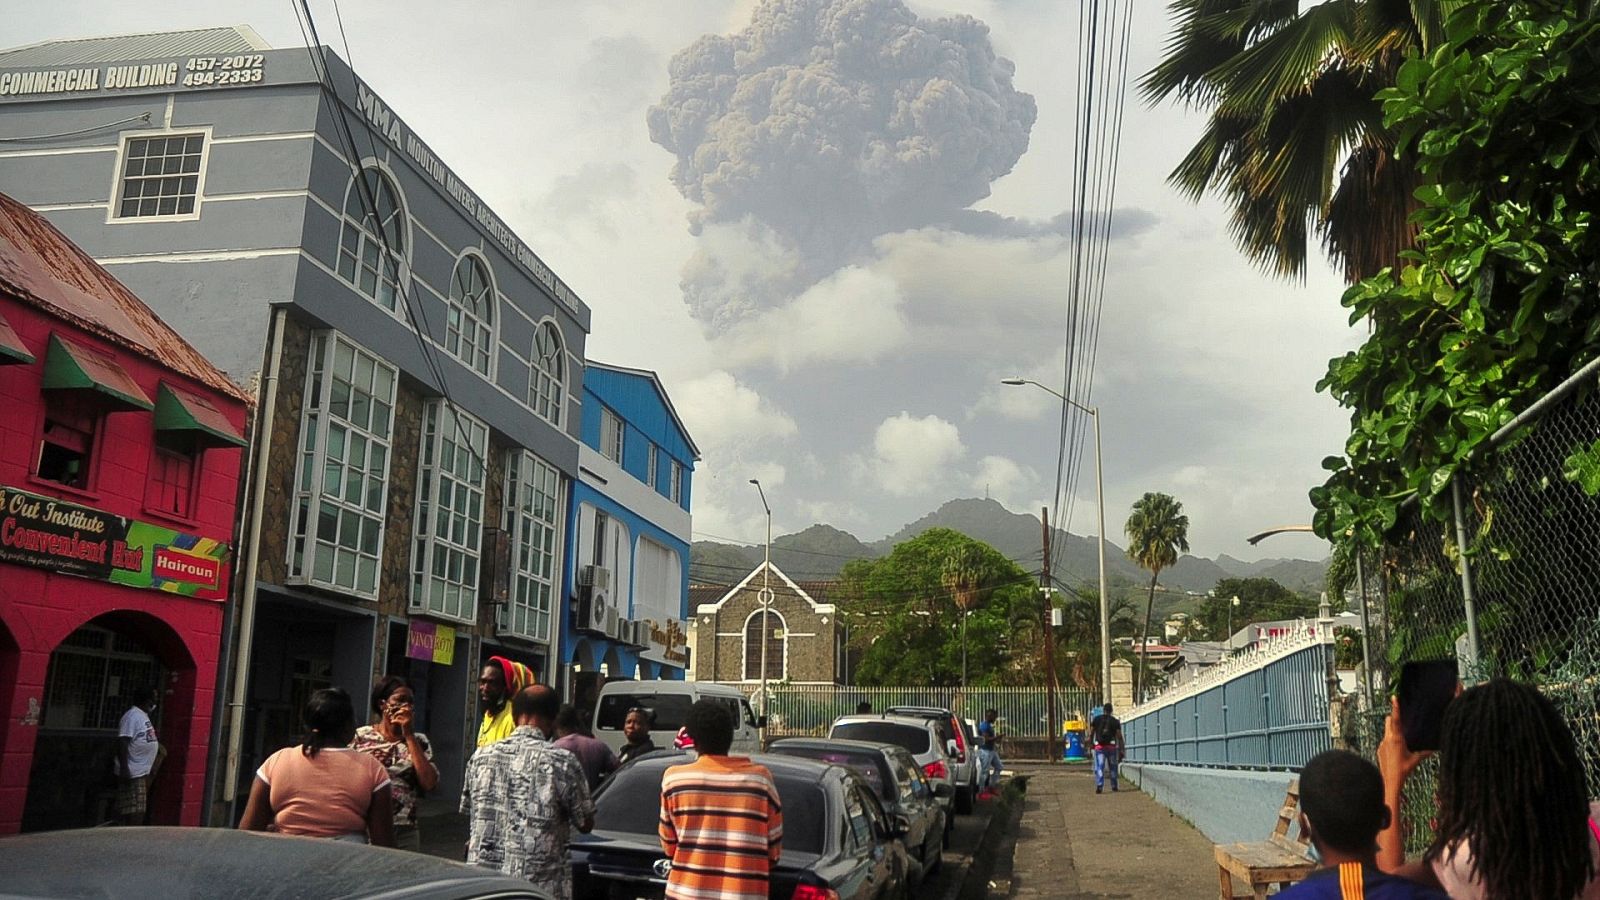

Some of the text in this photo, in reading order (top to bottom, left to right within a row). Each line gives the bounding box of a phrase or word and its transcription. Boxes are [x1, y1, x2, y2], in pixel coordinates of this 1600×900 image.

[0, 62, 178, 95] COMMERCIAL BUILDING
[182, 69, 262, 87] 494-2333
[185, 54, 264, 71] 457-2072
[356, 83, 402, 150] MMA
[406, 134, 446, 186] MOULTON
[476, 204, 517, 256] ARCHITECTS
[9, 493, 41, 519] Out
[42, 502, 105, 534] Institute
[2, 517, 107, 564] Convenient
[157, 555, 214, 579] Hairoun
